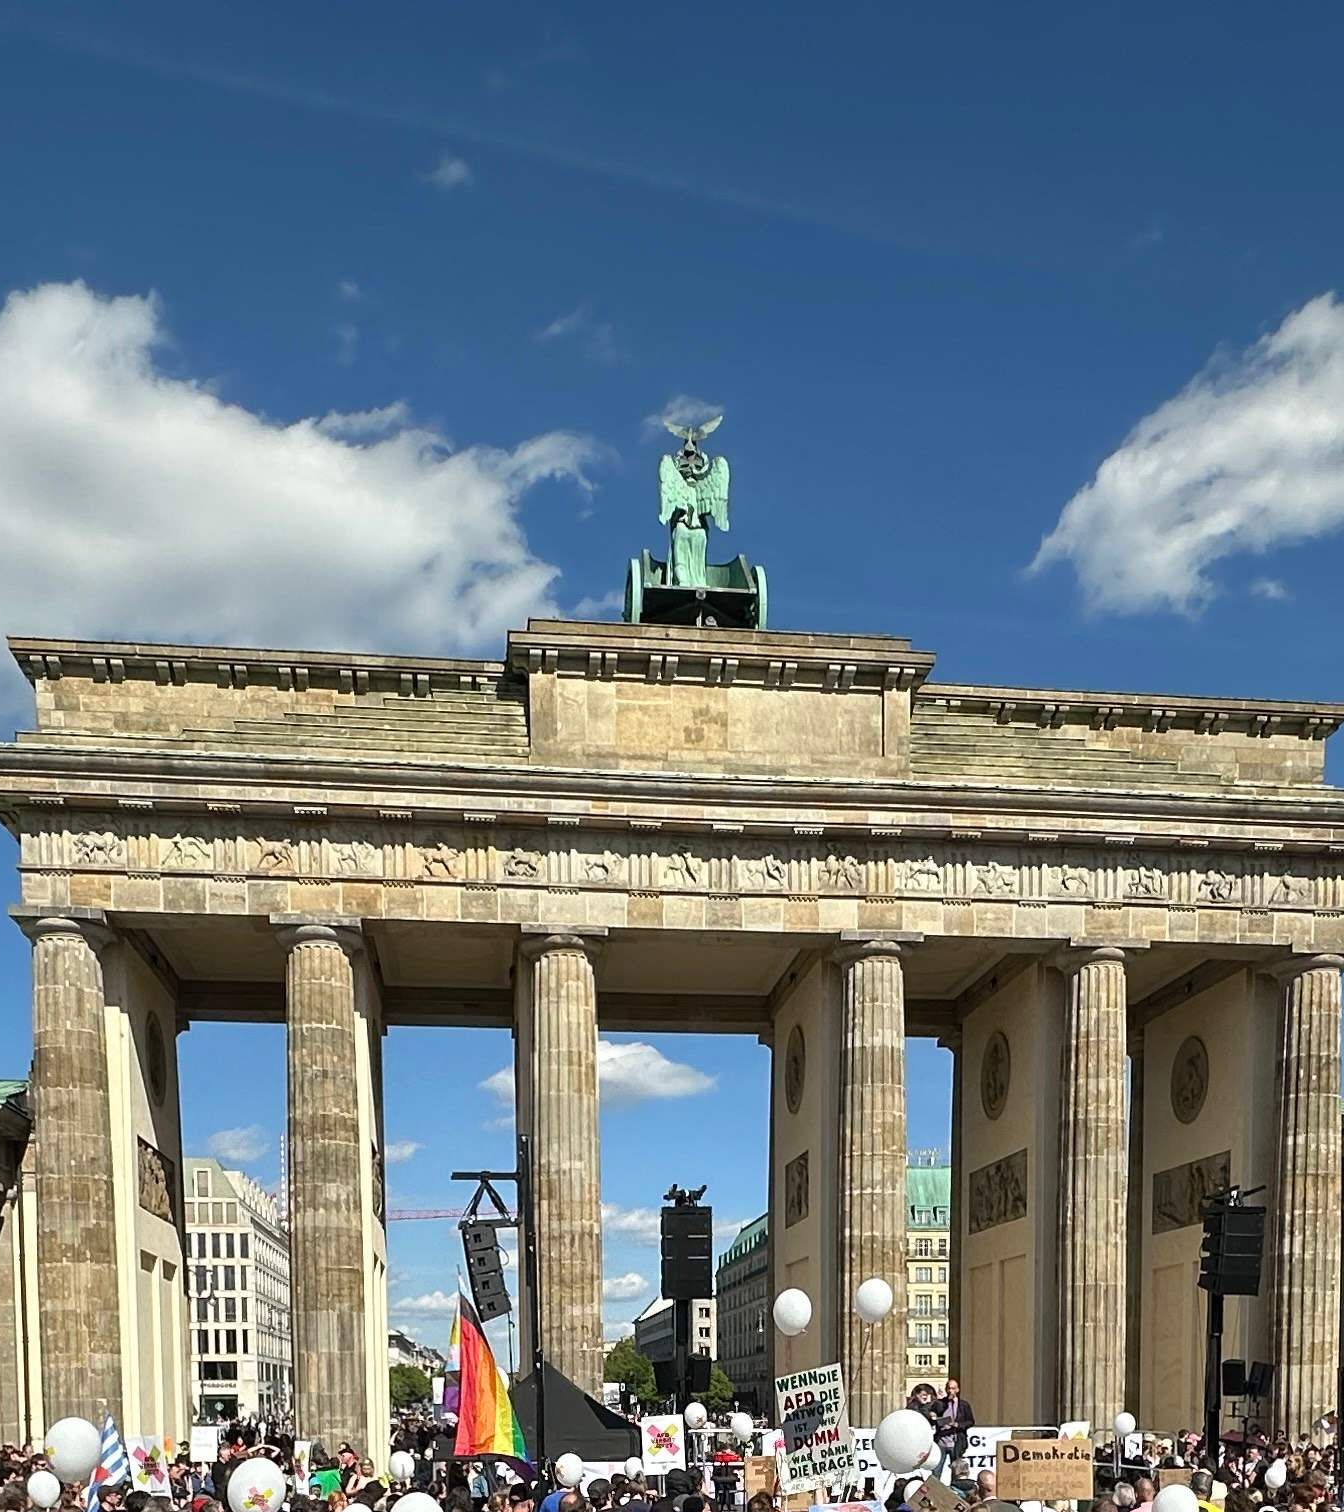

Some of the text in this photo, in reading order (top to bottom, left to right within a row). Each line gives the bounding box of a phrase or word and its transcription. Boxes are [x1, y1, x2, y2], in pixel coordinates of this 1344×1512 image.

[777, 1369, 839, 1392] WENN DIE
[784, 1388, 840, 1411] AFD DIE
[785, 1402, 839, 1423] ANTWORT
[793, 1427, 840, 1450] DUMM
[1002, 1445, 1091, 1463] Demokratie
[790, 1454, 854, 1479] DIE FRAGE
